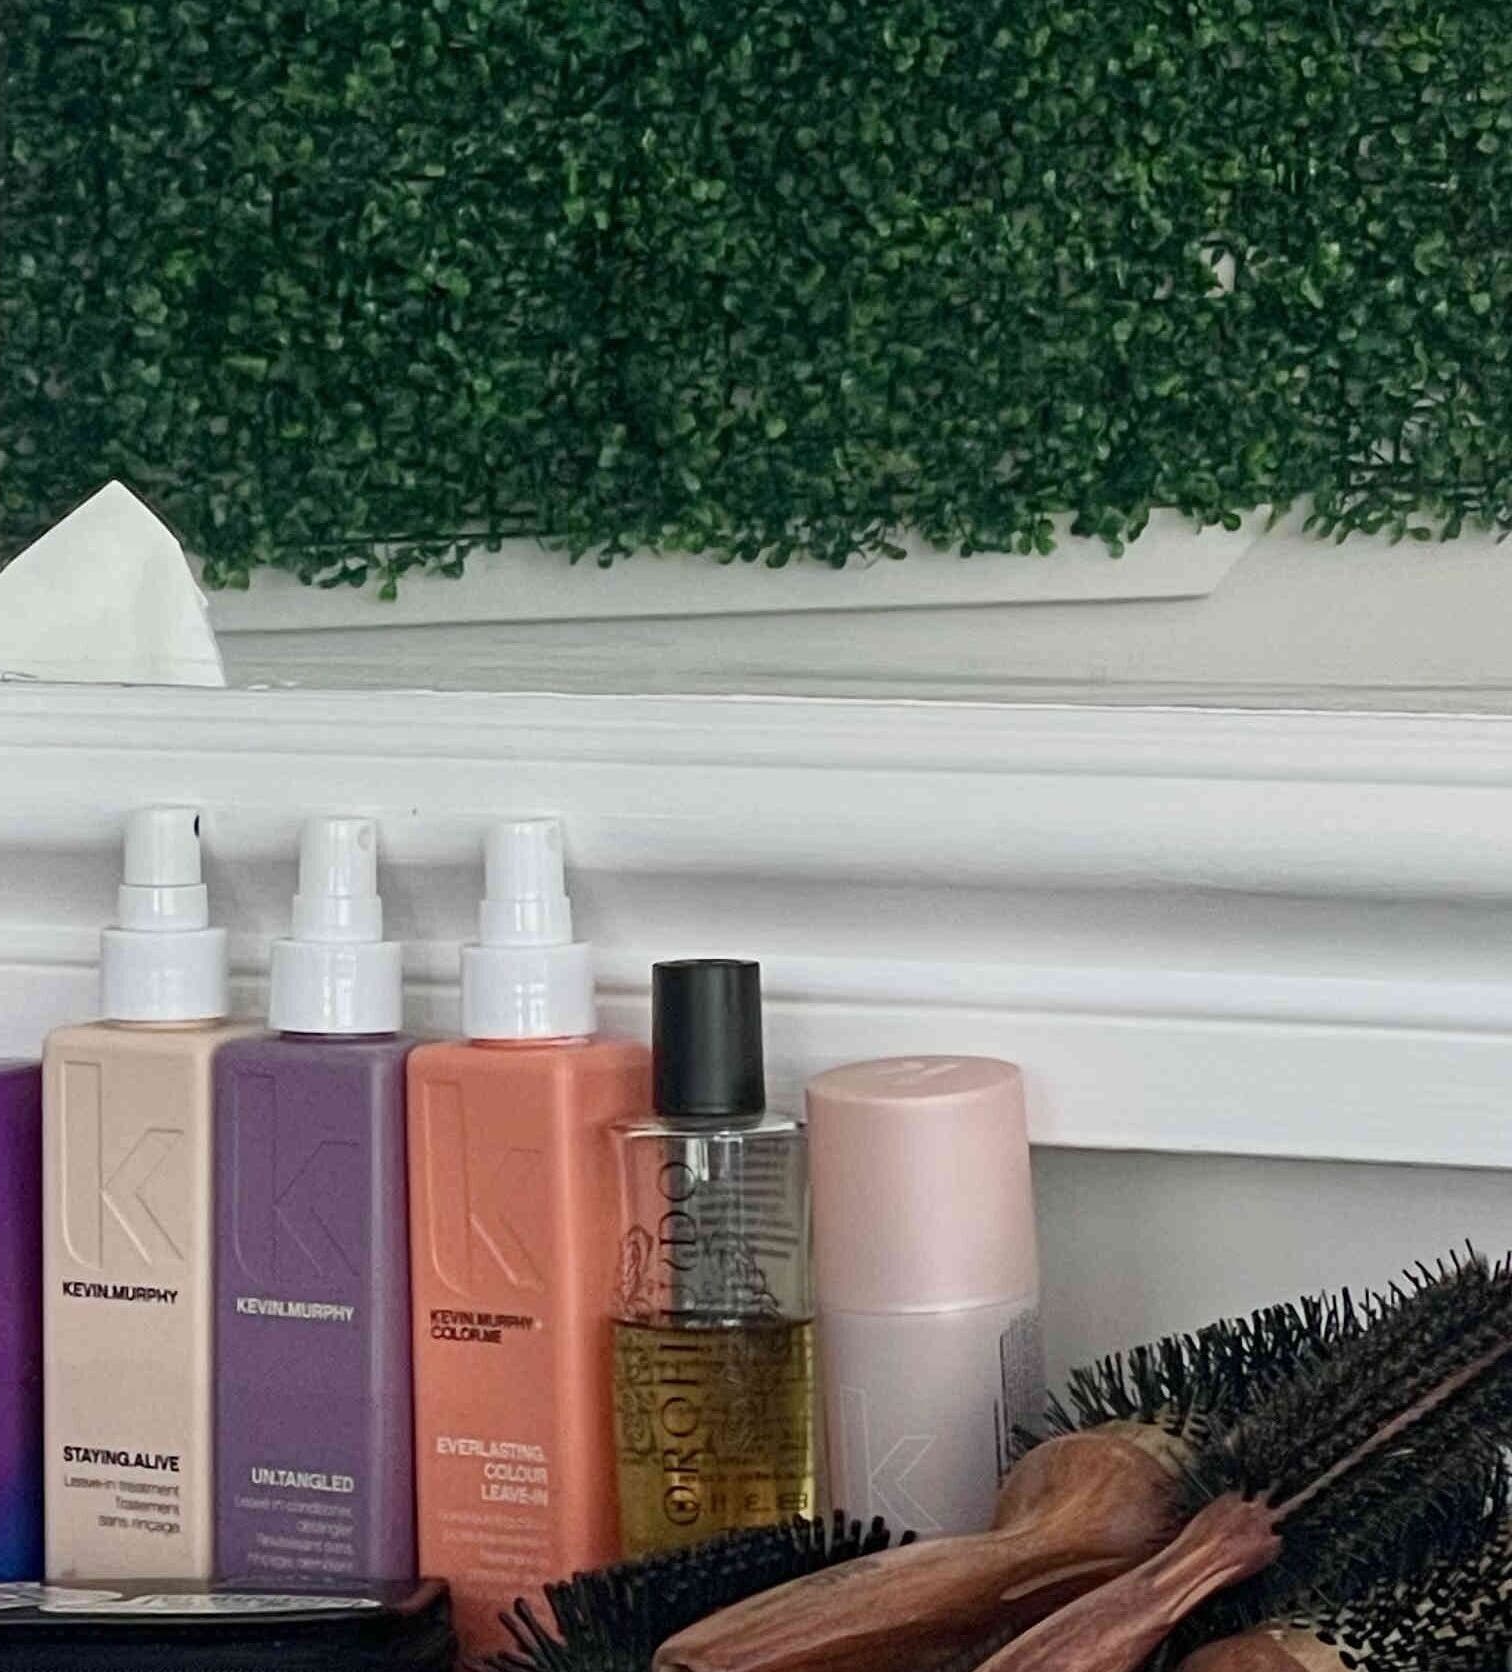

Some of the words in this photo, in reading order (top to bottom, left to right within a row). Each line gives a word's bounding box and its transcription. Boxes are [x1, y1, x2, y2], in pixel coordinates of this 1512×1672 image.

[62, 1281, 178, 1304] KEVIN.MURPHY
[236, 1297, 355, 1321] KEVIN.MURPHY
[63, 1446, 180, 1472] STAYING.ALIVE
[484, 1462, 548, 1484] COLOUR
[480, 1482, 549, 1507] LEAVE-IN
